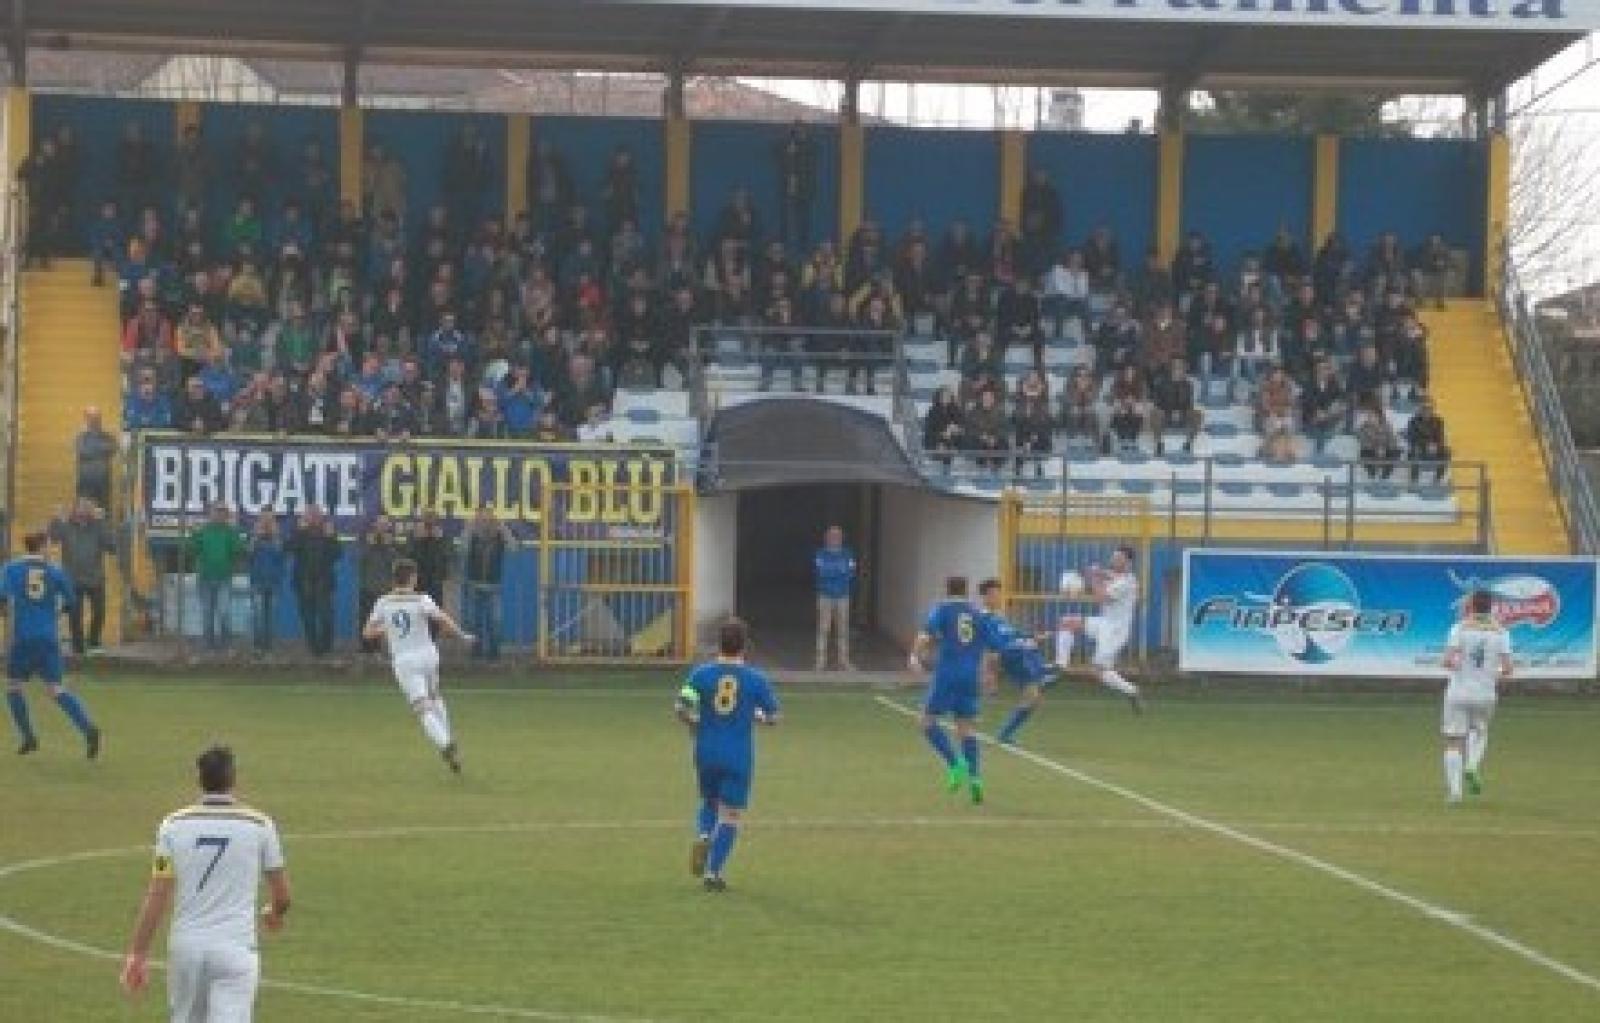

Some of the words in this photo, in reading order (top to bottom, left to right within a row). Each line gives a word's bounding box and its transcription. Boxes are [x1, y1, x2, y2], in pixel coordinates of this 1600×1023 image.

[151, 446, 358, 515] BRIGATE
[379, 455, 547, 520] GIALLO
[391, 608, 410, 639] 9
[714, 674, 738, 715] 8
[195, 836, 230, 893] 7
